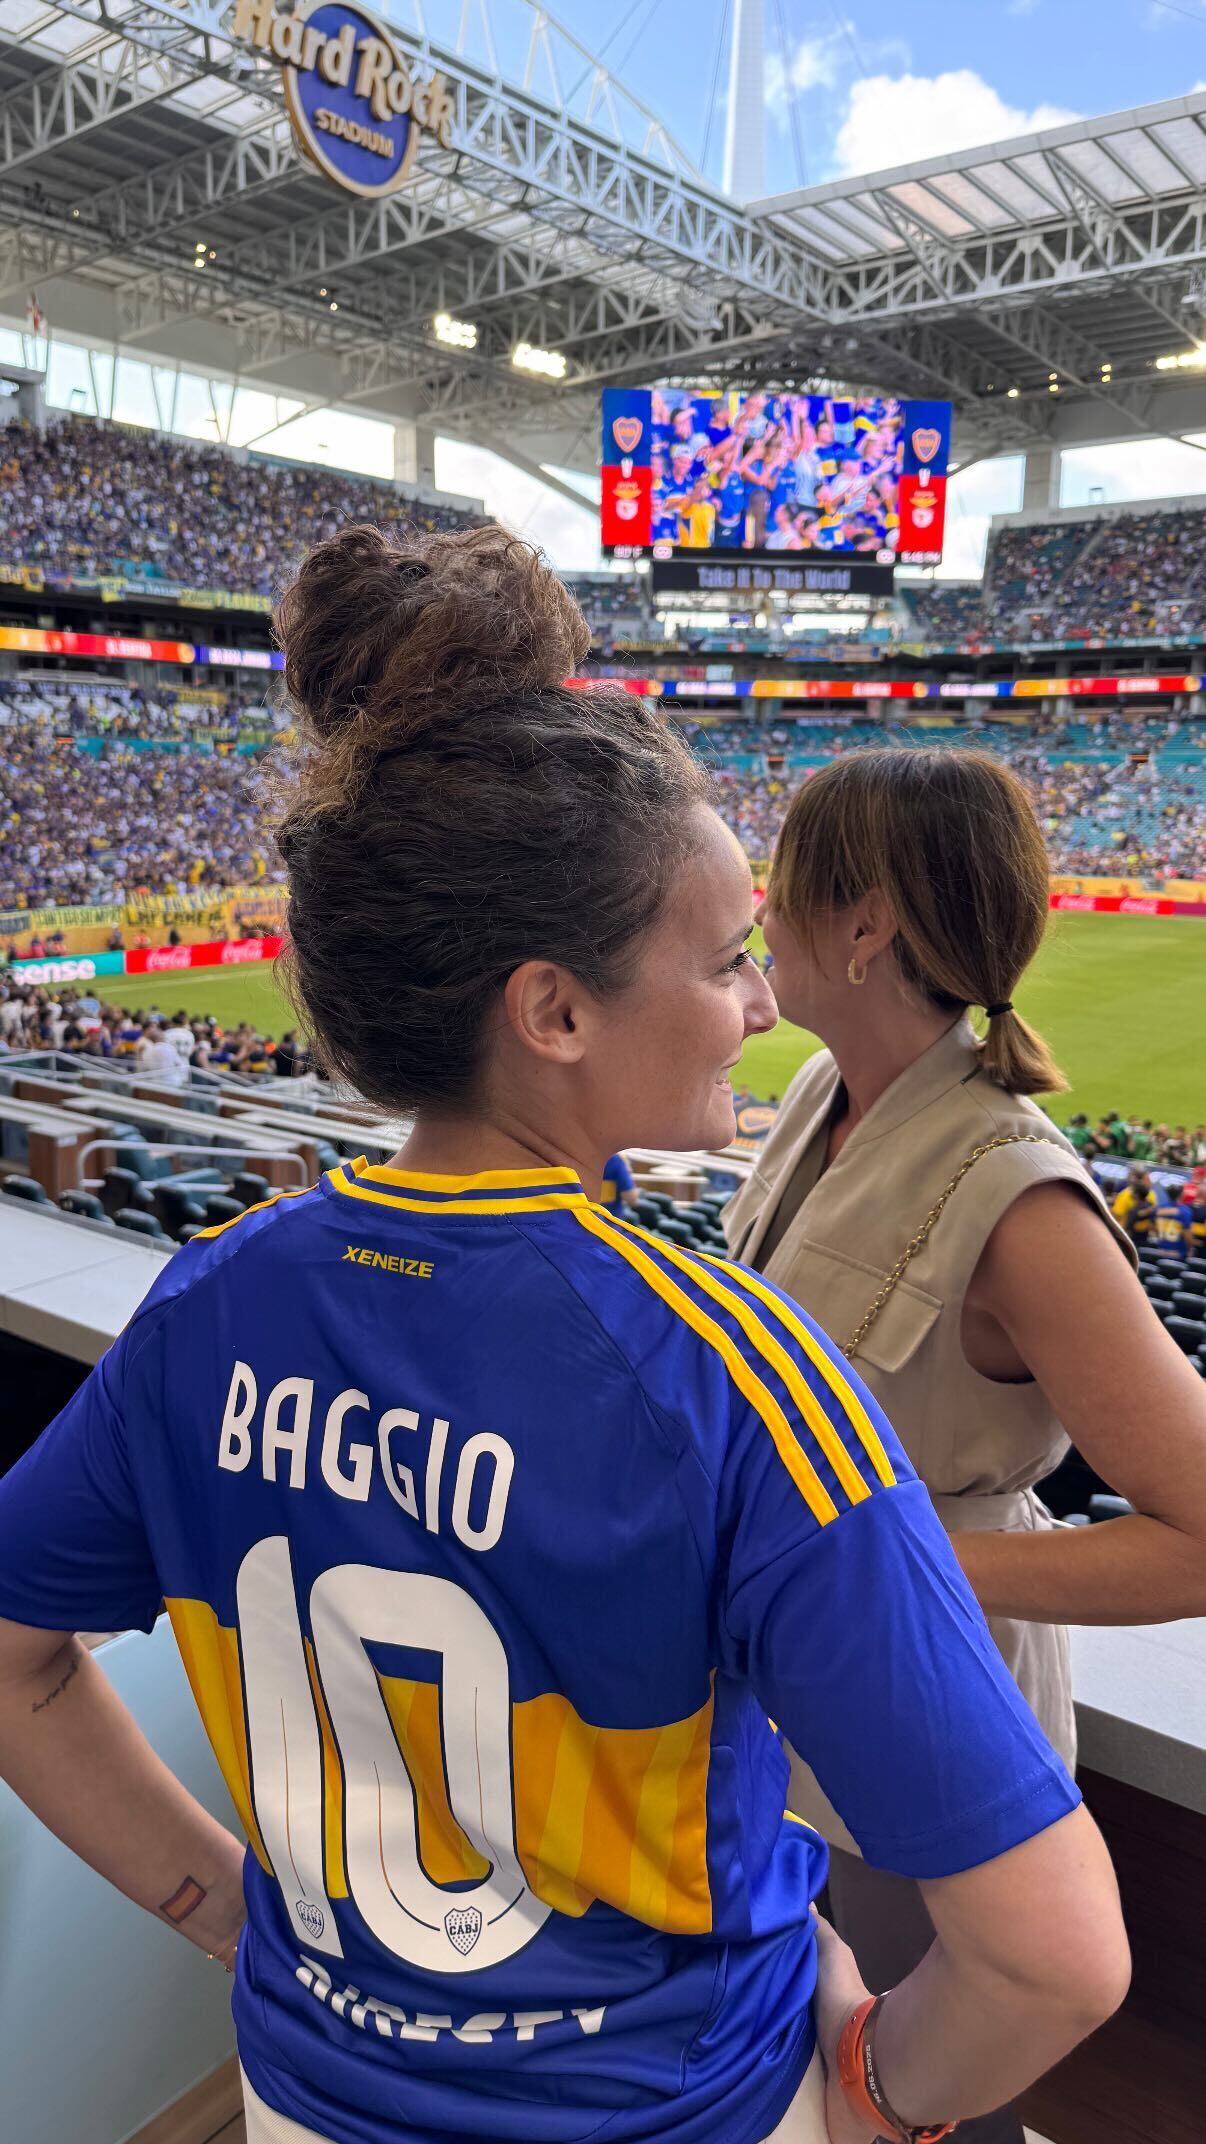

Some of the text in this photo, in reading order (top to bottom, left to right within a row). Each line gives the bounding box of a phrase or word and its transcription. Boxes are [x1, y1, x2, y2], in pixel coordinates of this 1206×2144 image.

[235, 0, 456, 149] Hard Rock
[314, 107, 394, 159] STADIUM
[697, 566, 735, 588] Take
[752, 567, 772, 589] To
[773, 568, 803, 589] The
[805, 568, 850, 590] World
[342, 1245, 435, 1279] XENEIZE
[218, 1360, 515, 1552] BAGGIO
[236, 1535, 553, 1973] 10
[449, 1922, 479, 1936] CABJ
